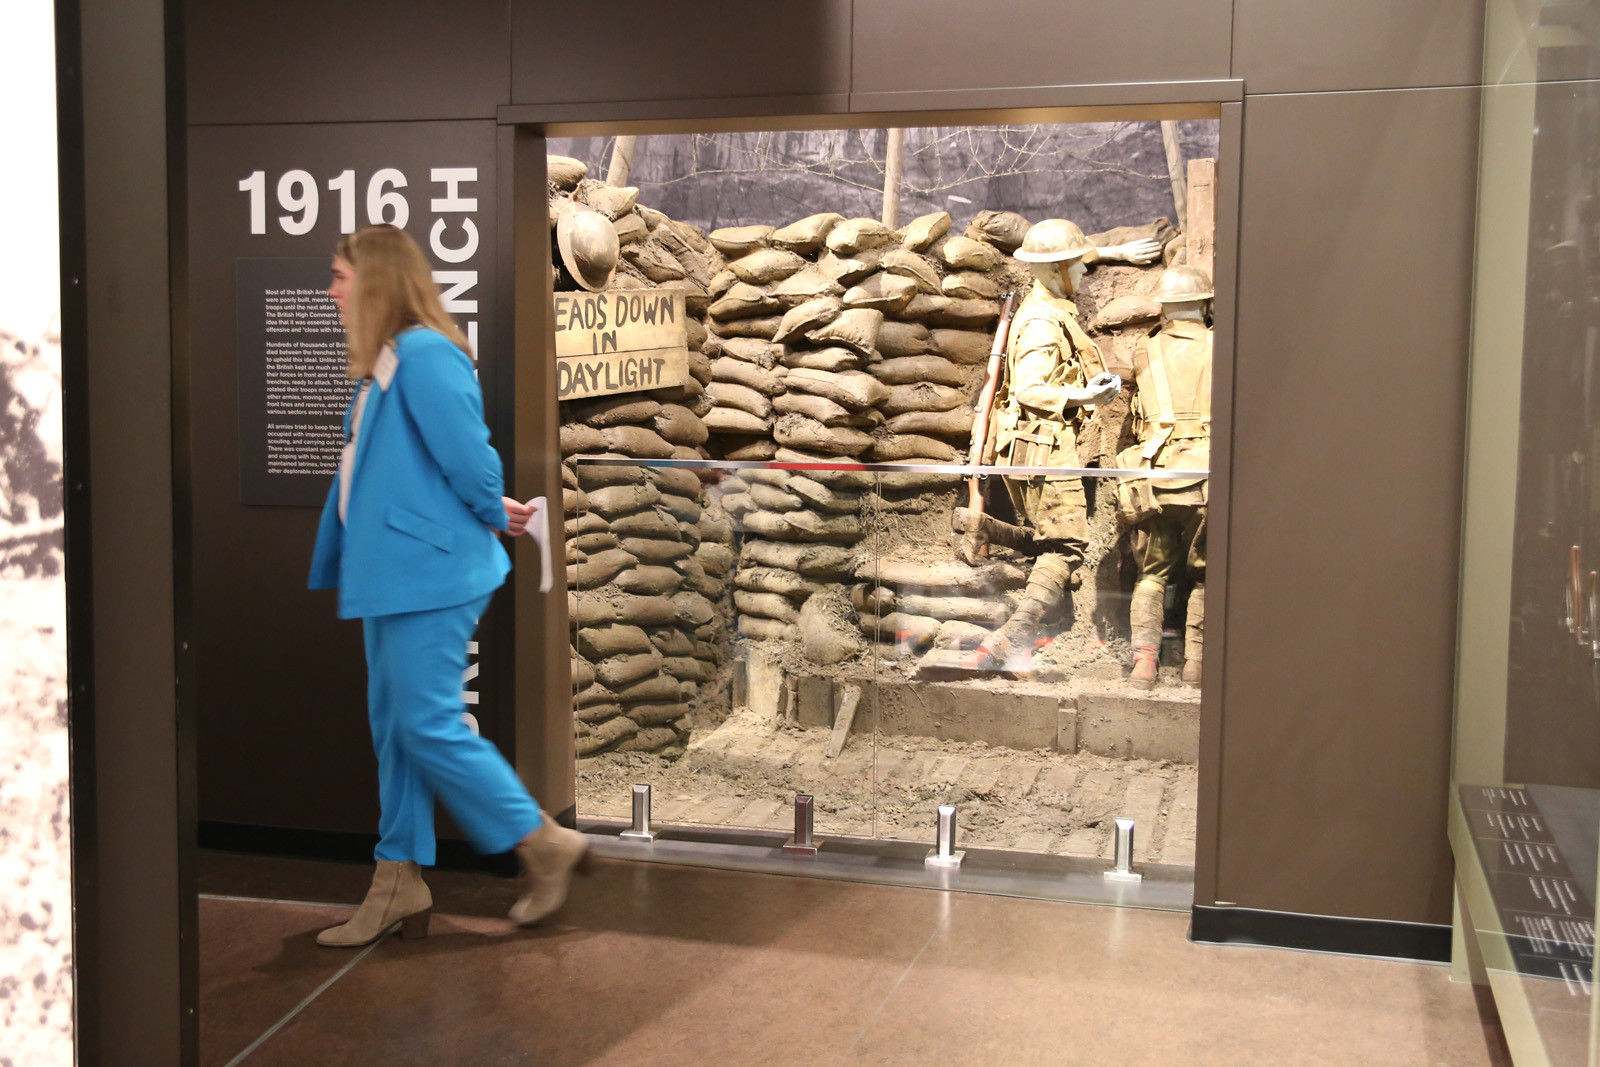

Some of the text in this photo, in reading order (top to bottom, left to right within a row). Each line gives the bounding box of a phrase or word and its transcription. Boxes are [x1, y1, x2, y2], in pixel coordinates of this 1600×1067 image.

[238, 168, 410, 236] 1916
[555, 294, 674, 331] EADS DOWN
[593, 330, 617, 355] IN
[558, 357, 665, 396] DAYLIGHT
